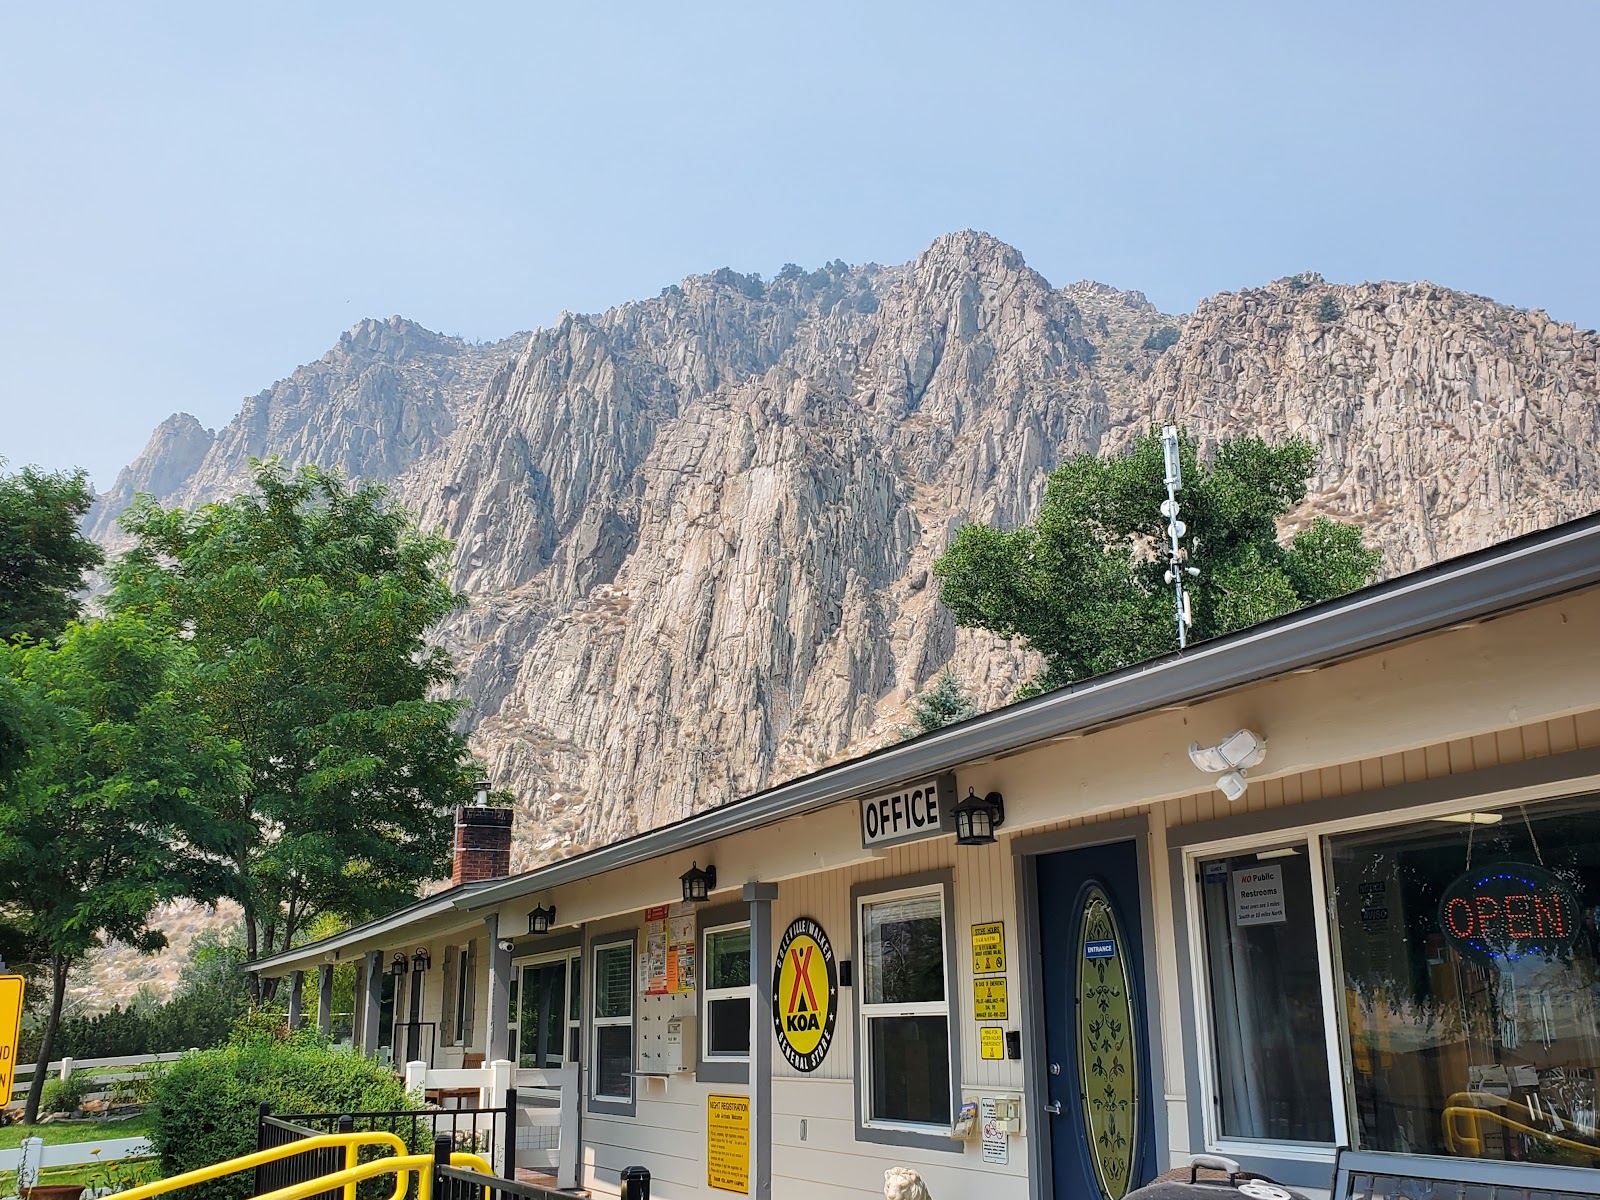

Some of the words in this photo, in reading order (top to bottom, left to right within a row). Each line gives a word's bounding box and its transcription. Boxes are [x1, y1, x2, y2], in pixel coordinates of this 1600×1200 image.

[866, 786, 938, 838] OFFICE
[1241, 875, 1252, 883] NO
[1253, 873, 1274, 883] Public
[1360, 883, 1384, 892] NOTICE
[1241, 888, 1278, 898] Restrooms
[1363, 910, 1387, 919] AVISO
[1446, 894, 1566, 938] OPEN
[975, 927, 986, 935] STORE
[987, 926, 1000, 934] HOURS
[1087, 945, 1112, 953] ENTRANCE
[786, 1013, 821, 1032] KOA
[778, 1031, 809, 1070] GENERAL
[811, 1028, 831, 1067] STORE
[721, 1101, 749, 1112] REGISTRATION
